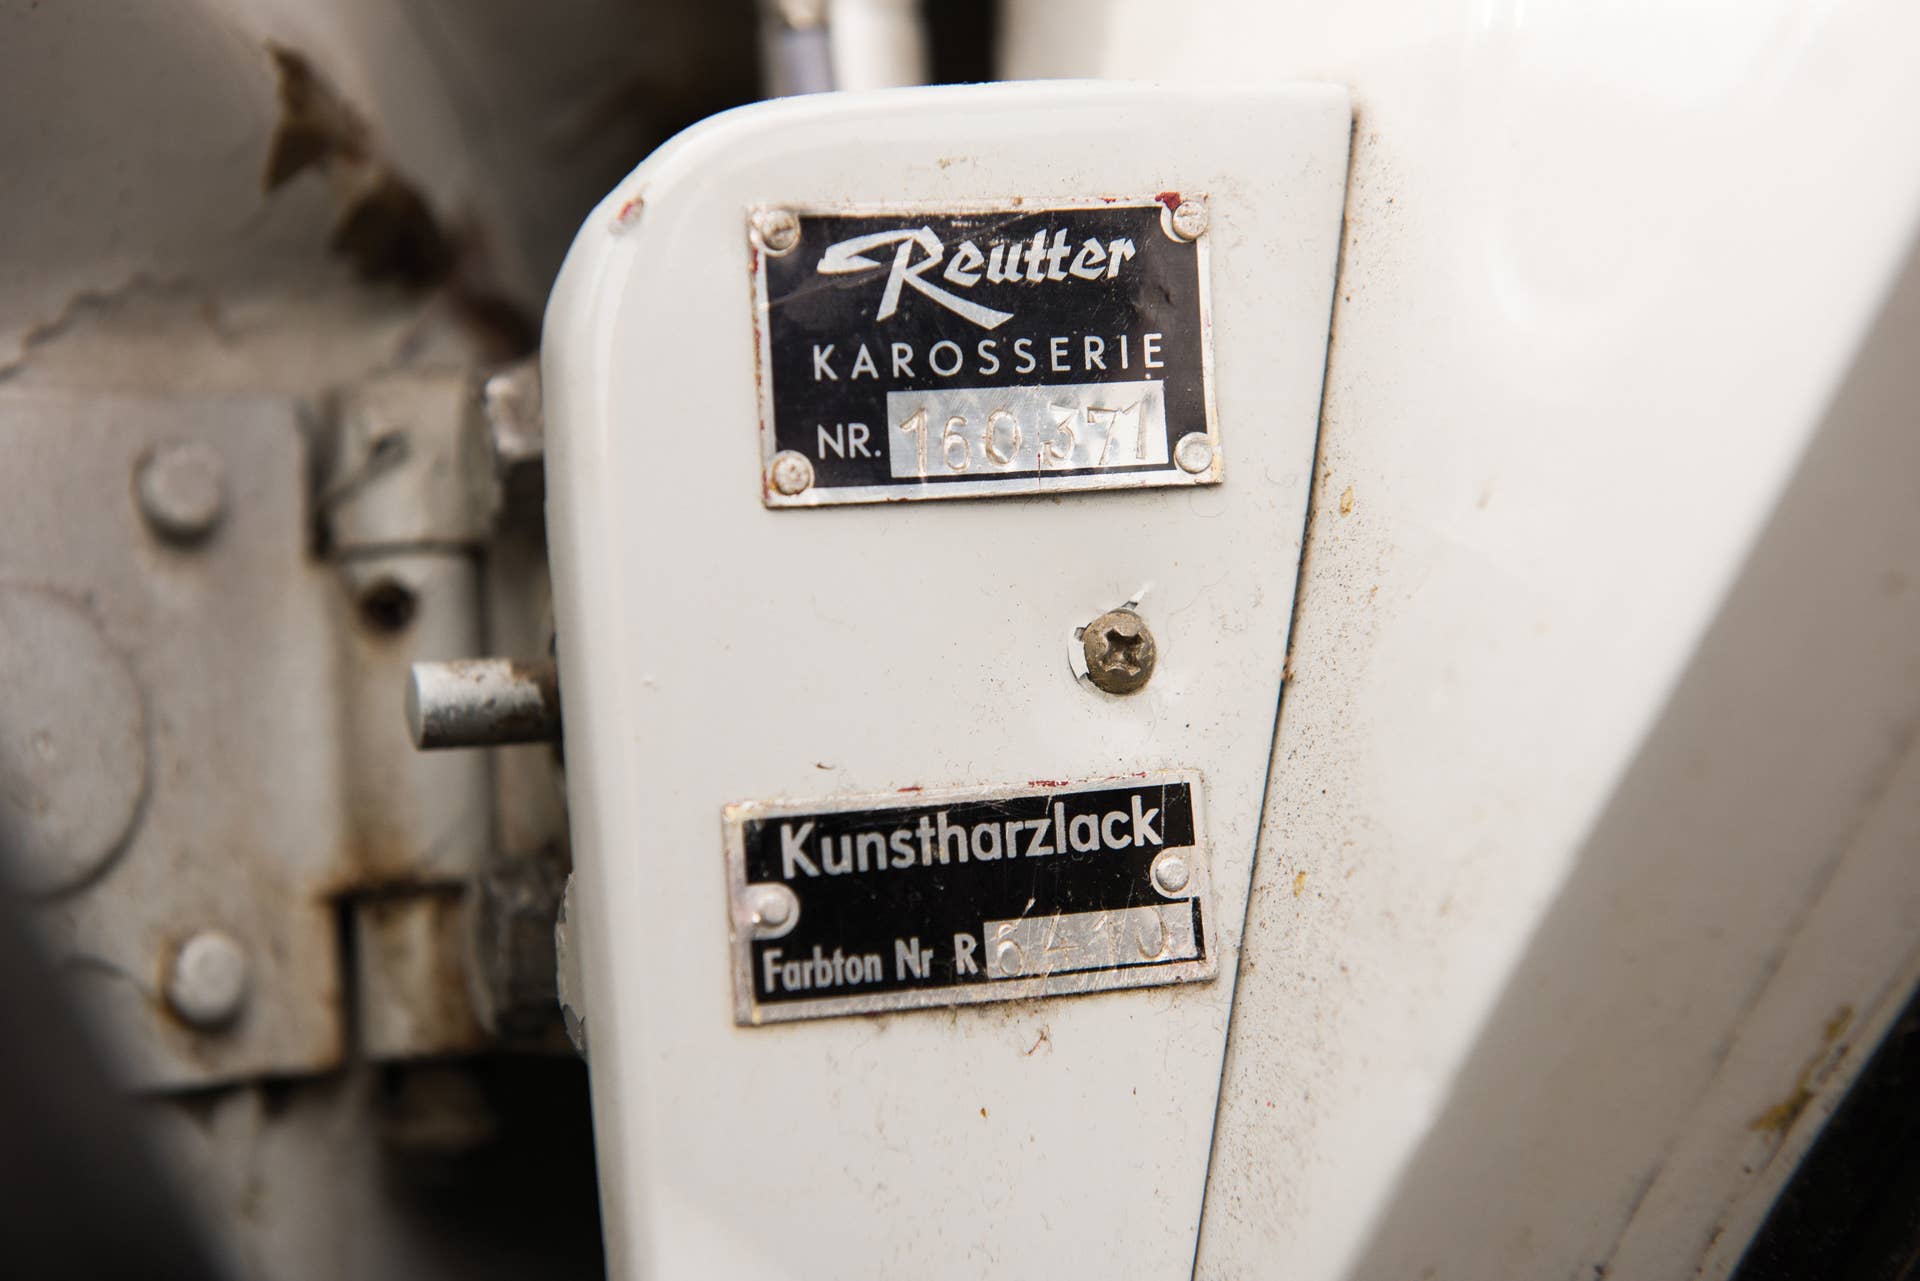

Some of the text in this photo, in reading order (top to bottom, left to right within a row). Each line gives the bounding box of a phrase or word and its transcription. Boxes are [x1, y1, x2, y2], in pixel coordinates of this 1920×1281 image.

[817, 225, 1136, 330] Reutter
[813, 332, 1164, 382] KAROSSERIE
[817, 422, 882, 460] NR.
[779, 795, 1164, 879] Kunstharzlack
[762, 945, 883, 994] Farbton
[894, 938, 934, 983] Nr
[953, 932, 979, 975] R
